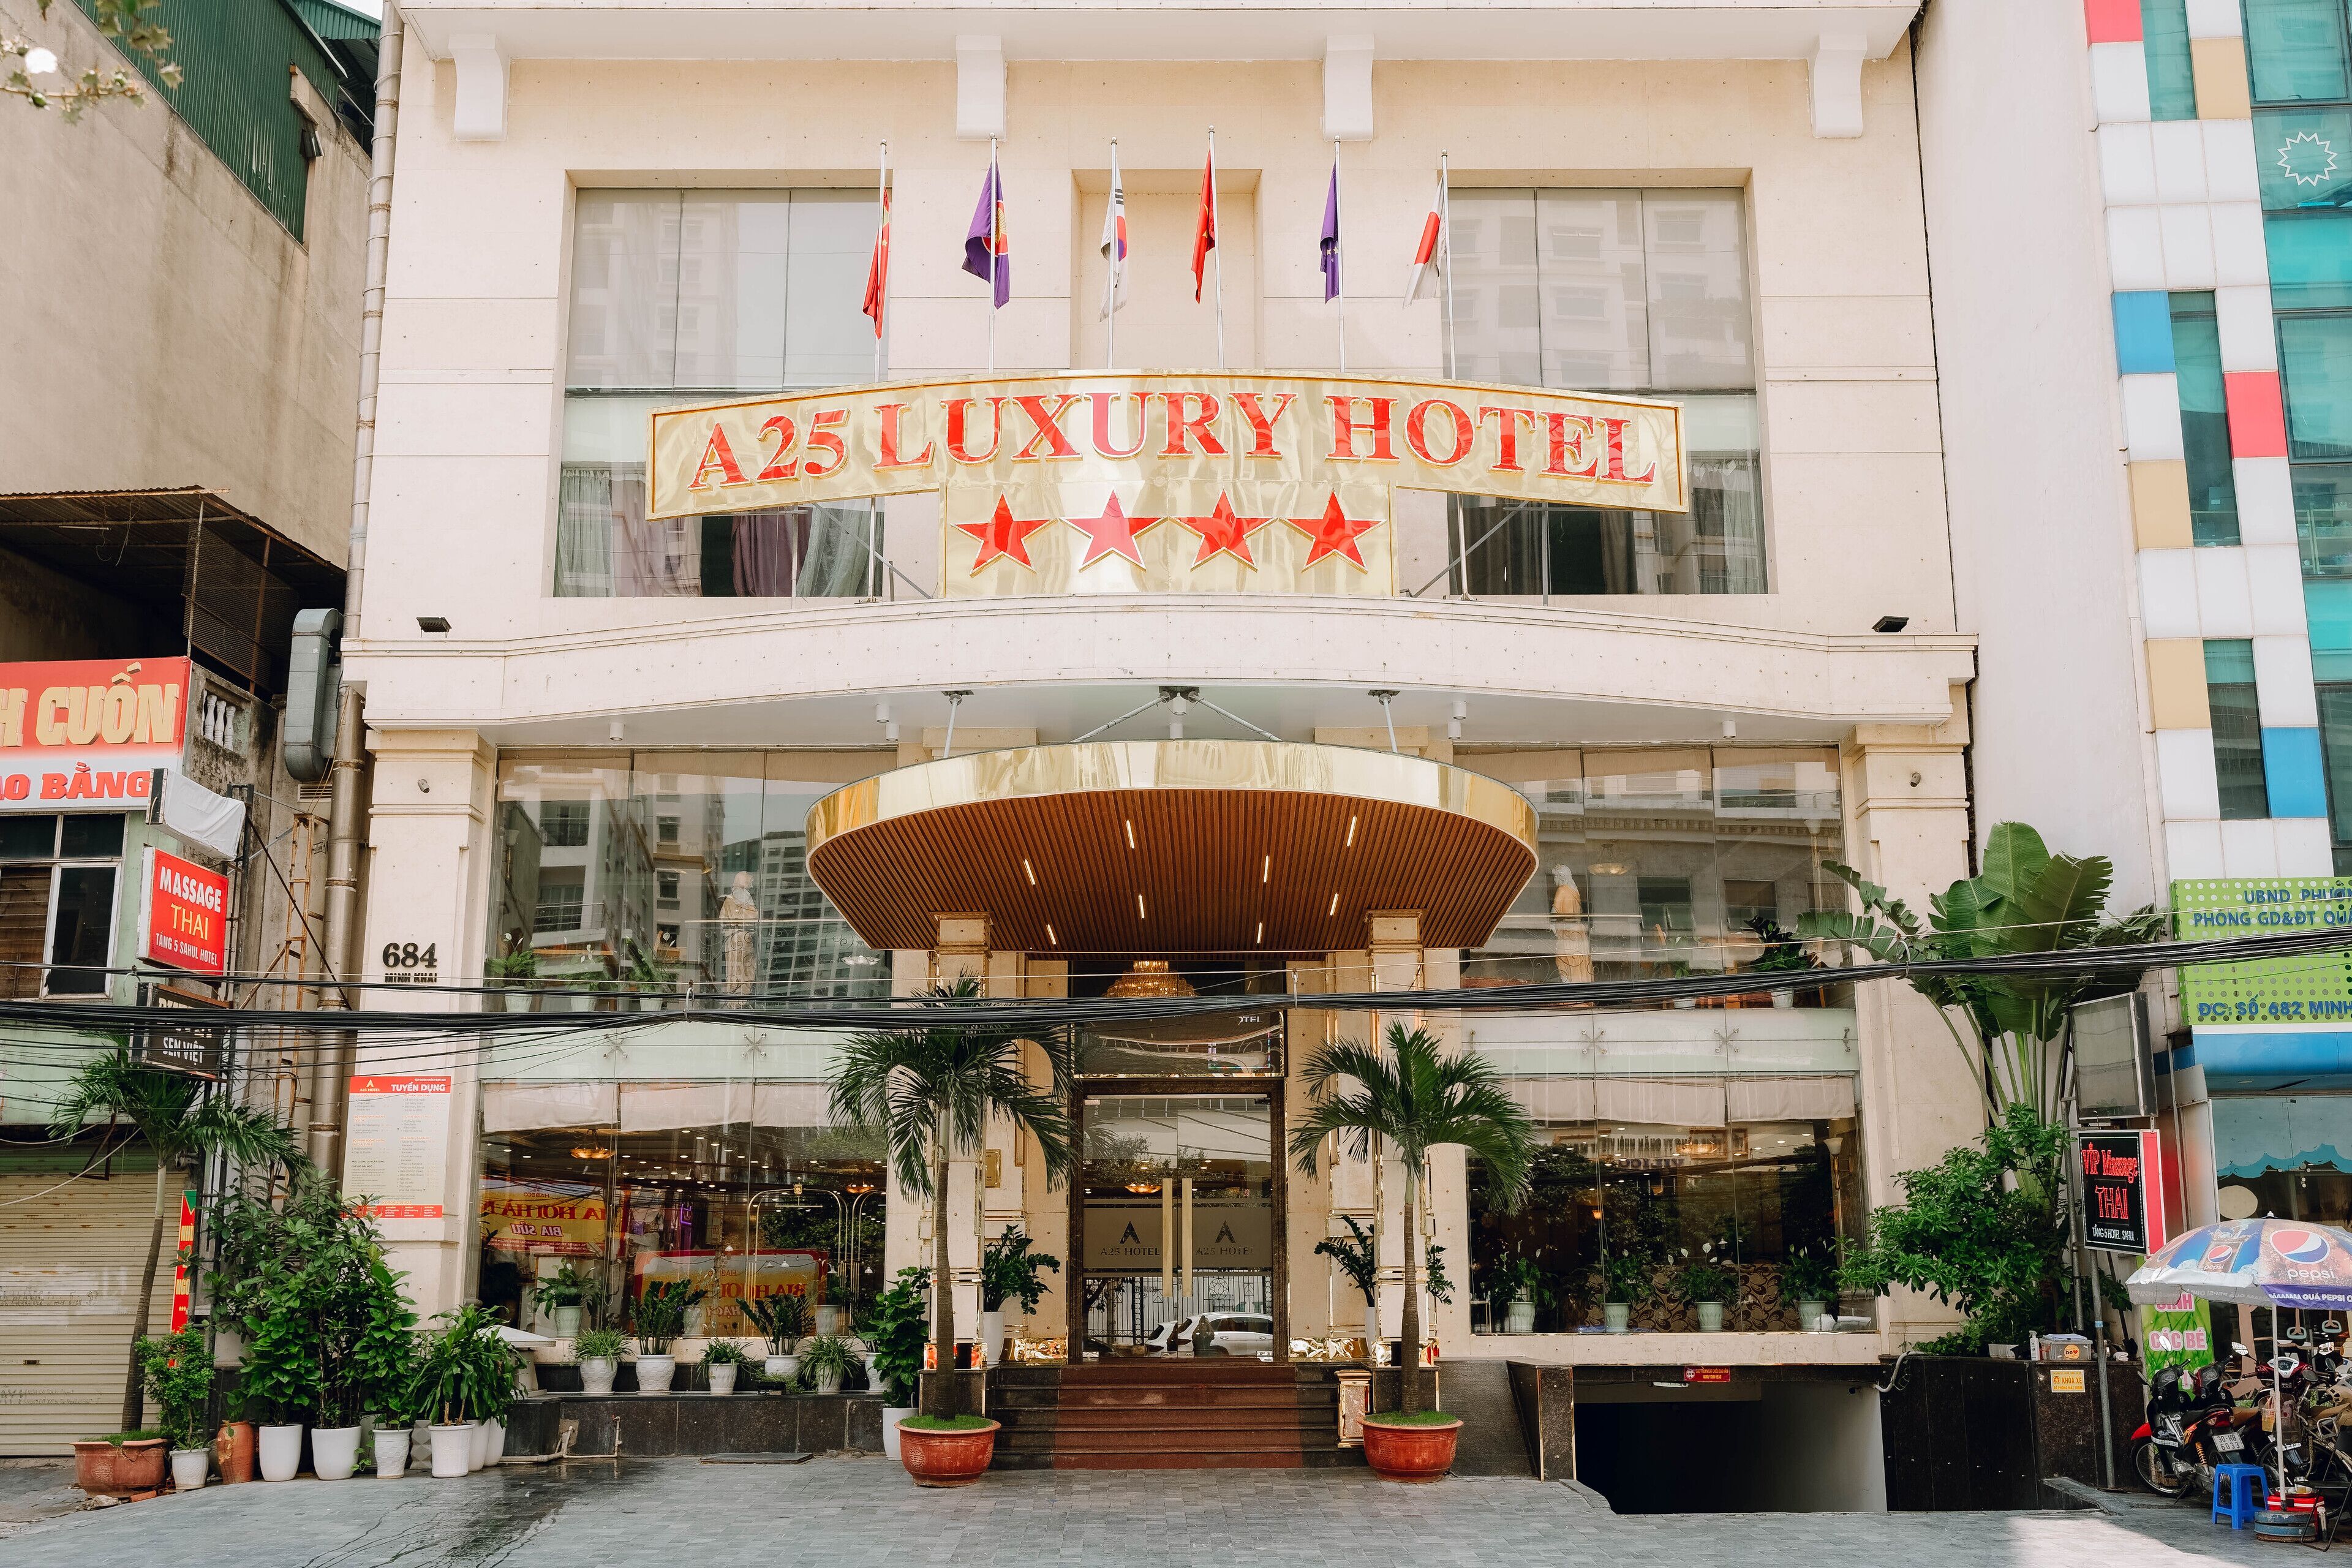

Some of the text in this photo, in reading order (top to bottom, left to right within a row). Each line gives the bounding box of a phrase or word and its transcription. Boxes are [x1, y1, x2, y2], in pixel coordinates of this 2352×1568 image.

[688, 391, 1657, 493] A25 LUXURY HOTEL
[36, 661, 180, 745] CUỐN
[39, 761, 151, 799] BẰNG
[159, 865, 222, 913] MASSAGE
[2244, 889, 2291, 904] UBND
[171, 903, 209, 941] THAI
[2258, 911, 2316, 926] GD&ĐT
[174, 940, 178, 952] 5
[179, 941, 199, 960] SAHUL
[200, 949, 218, 966] HOTEL
[382, 943, 437, 968] 684
[385, 973, 437, 983] MINH KHAI
[2237, 993, 2259, 1016] SỐ
[2268, 1001, 2302, 1016] 682
[162, 1037, 205, 1066] SEN VIỆT
[391, 1081, 446, 1093] TUYỂN DỤNG
[2082, 1149, 2138, 1183] VIP Massage
[2095, 1185, 2128, 1219] THAI
[2104, 1228, 2108, 1238] 5
[2108, 1228, 2120, 1240] HOTEL
[2122, 1229, 2135, 1241] SAHUL
[1101, 1247, 1160, 1256] A25 HOTEL
[1196, 1247, 1254, 1256] A25 HOTEL
[2287, 1268, 2336, 1280] pepsi
[2321, 1294, 2345, 1302] PEPSI
[2186, 1329, 2206, 1348] BÉ
[2220, 1442, 2240, 1450] 6033
